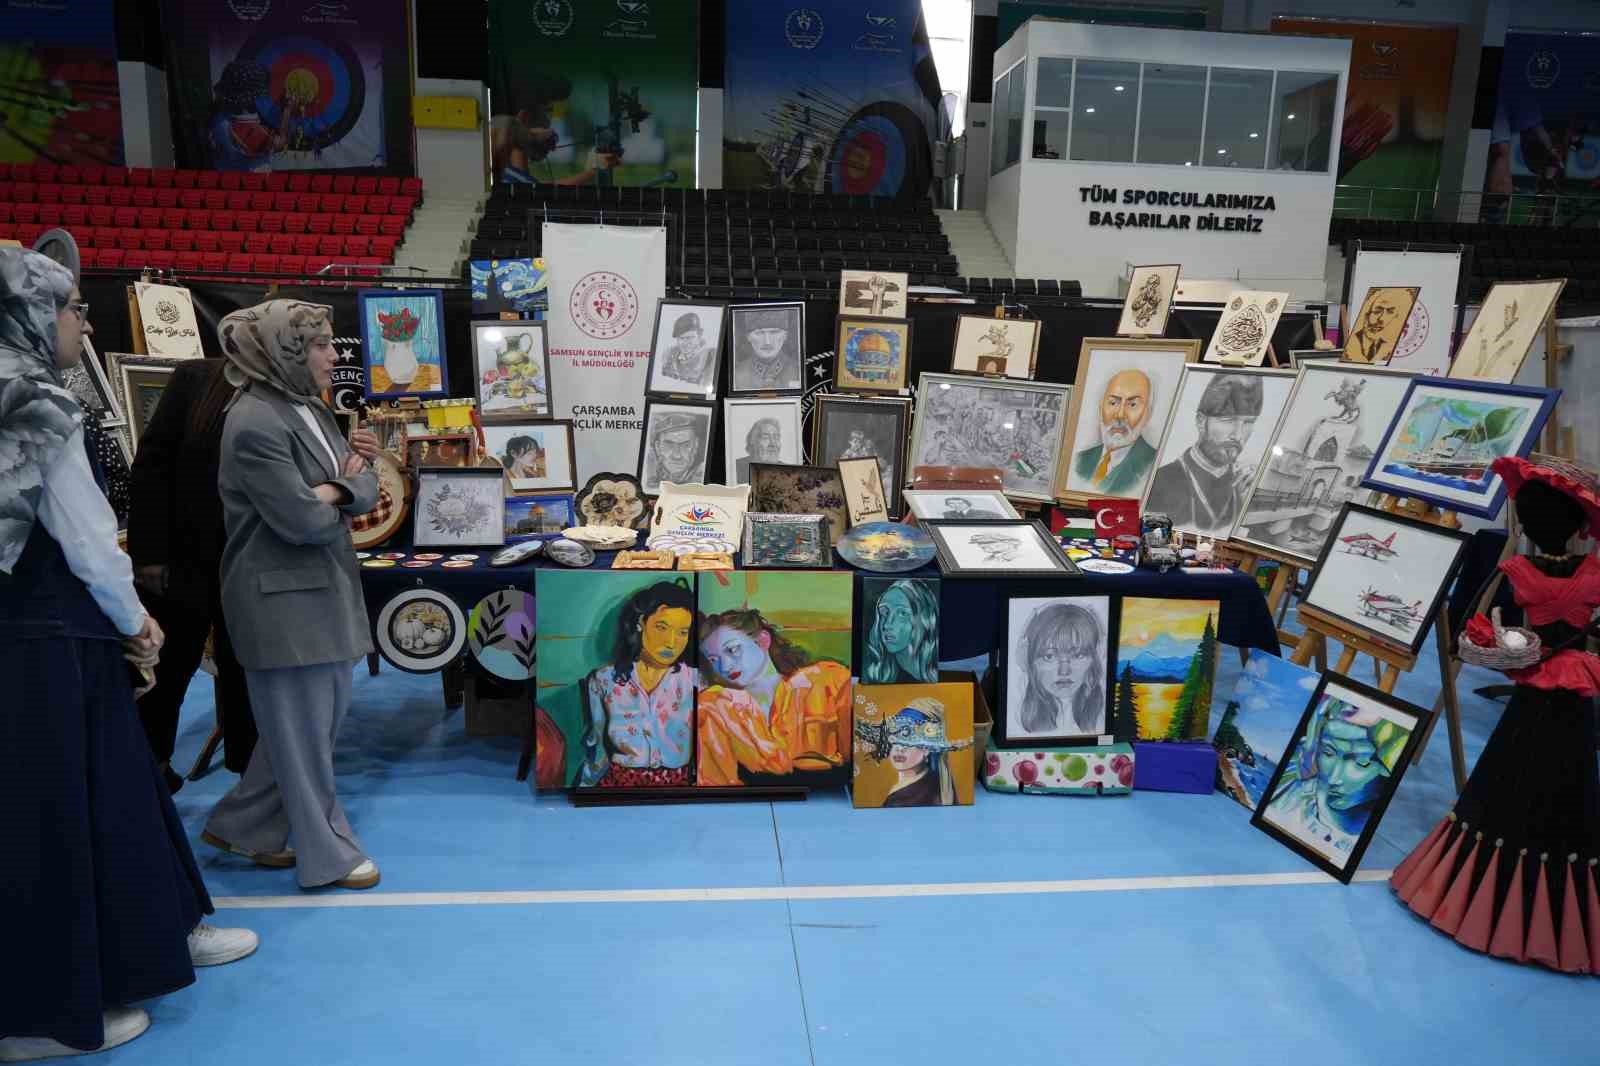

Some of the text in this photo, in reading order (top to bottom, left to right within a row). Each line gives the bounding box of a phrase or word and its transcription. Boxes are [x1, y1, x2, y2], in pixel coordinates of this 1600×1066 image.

[1079, 184, 1276, 211] TÜM SPORCULARIMIZA
[1089, 211, 1264, 233] BAŞARILAR DİLERİZ
[550, 349, 585, 357] SAMSUN
[587, 349, 622, 359] GENÇLİK
[572, 405, 636, 418] ÇARŞAMBA
